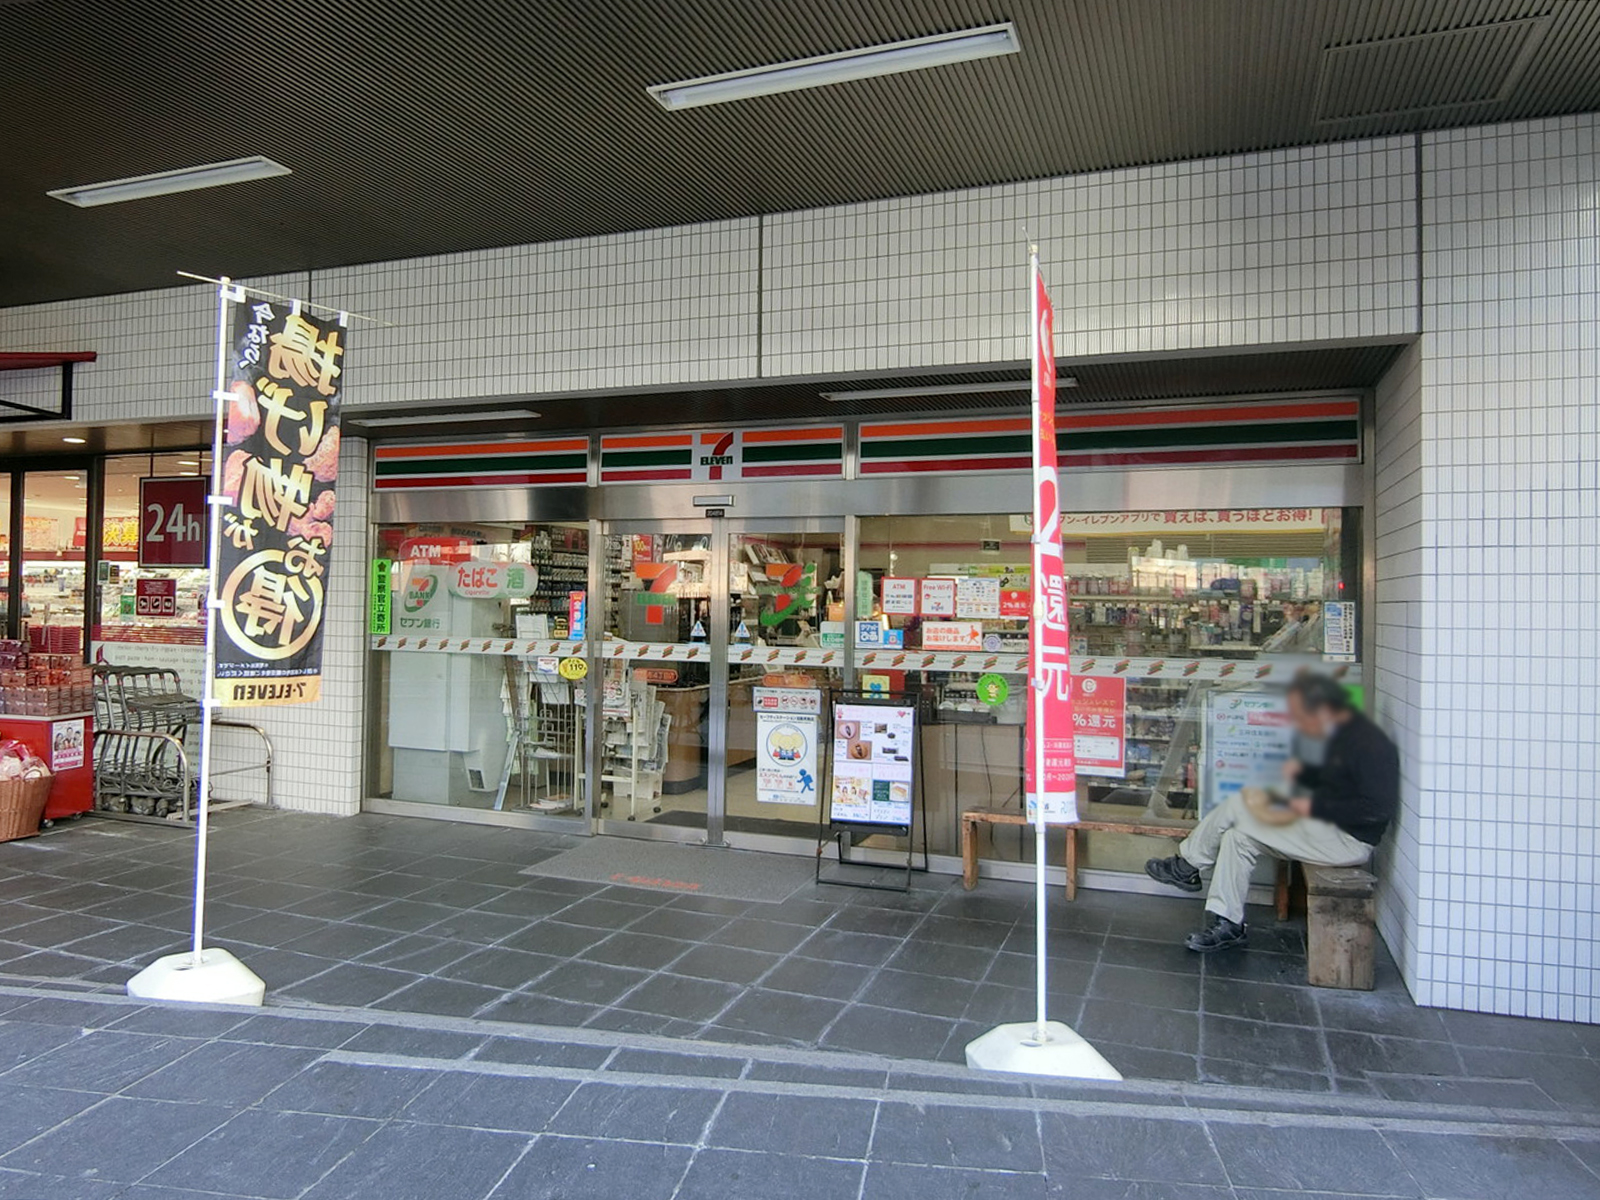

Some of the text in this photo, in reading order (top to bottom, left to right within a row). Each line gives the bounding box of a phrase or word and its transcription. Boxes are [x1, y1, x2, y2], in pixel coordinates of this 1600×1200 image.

[146, 503, 200, 542] 24h
[410, 545, 441, 558] ATM
[457, 567, 525, 589] たばこ 酒
[376, 573, 387, 633] 警察官立寄所
[400, 617, 441, 629] セブン銀行
[926, 627, 960, 635] お店の商品
